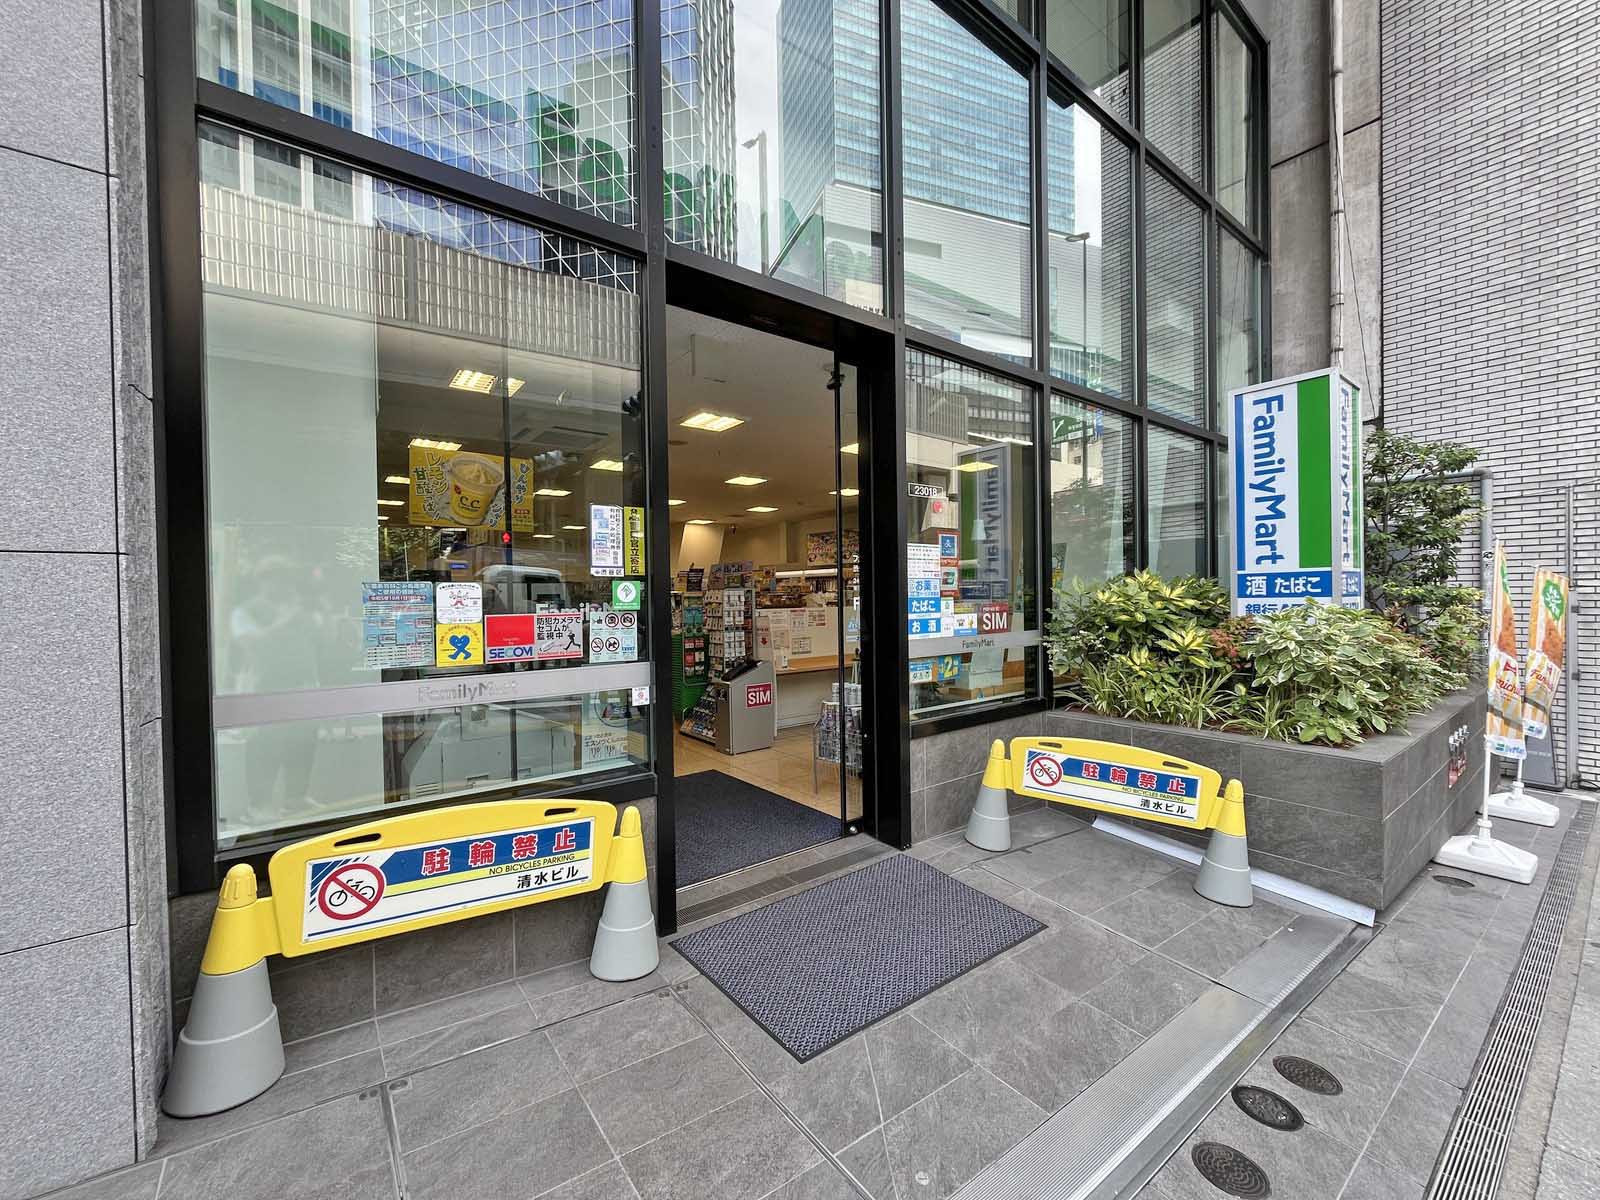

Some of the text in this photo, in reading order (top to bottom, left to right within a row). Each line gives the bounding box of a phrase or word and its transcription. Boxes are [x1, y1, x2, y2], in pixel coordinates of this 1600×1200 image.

[1249, 394, 1286, 566] FamilyMart
[914, 485, 938, 497] 23018
[1246, 575, 1267, 596] 酒
[1274, 576, 1322, 594] たばこ
[912, 600, 936, 612] たばこ
[536, 616, 581, 626] 防犯カメラで
[983, 612, 1007, 630] SIM
[536, 631, 563, 640] 監視中
[489, 647, 533, 659] SECOM
[748, 690, 770, 704] SIM
[1082, 762, 1186, 795] 駐輪禁止
[1140, 798, 1187, 814] 清水ビル
[421, 828, 577, 875] 駐輪禁止
[488, 853, 576, 876] NO BICYCLES PARKING
[517, 865, 579, 889] 清水ビル
